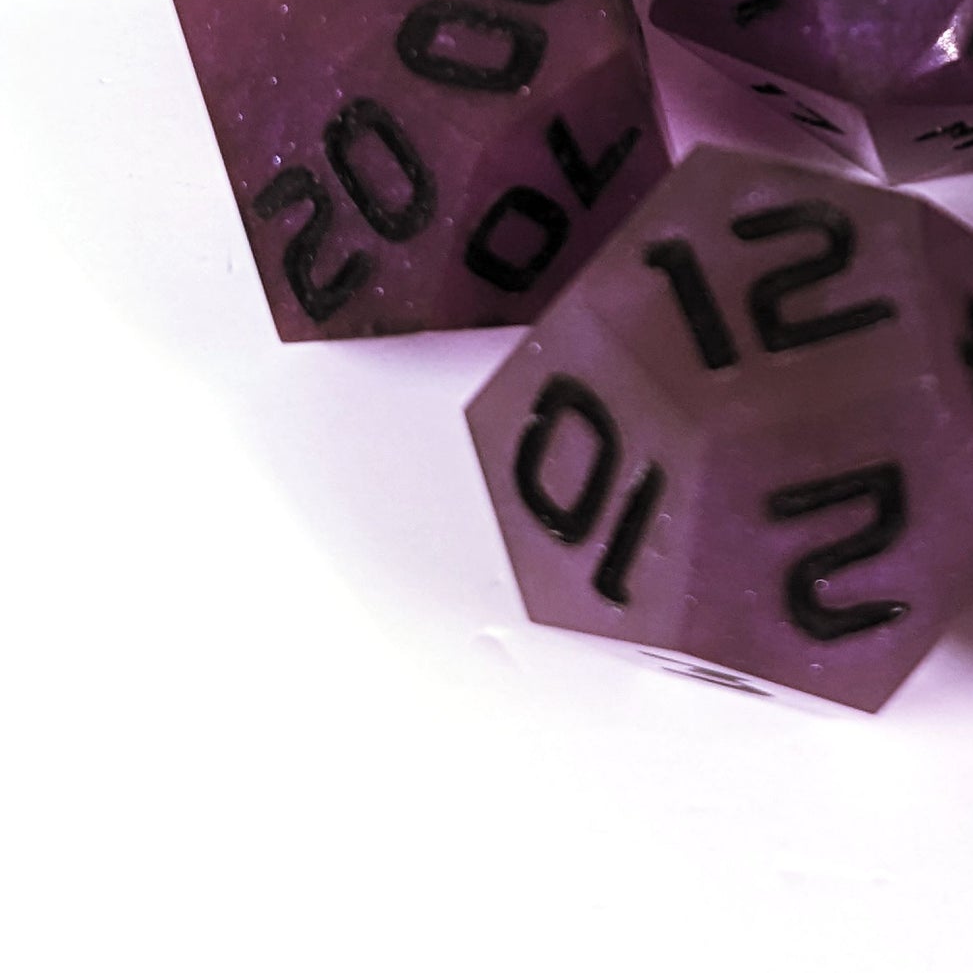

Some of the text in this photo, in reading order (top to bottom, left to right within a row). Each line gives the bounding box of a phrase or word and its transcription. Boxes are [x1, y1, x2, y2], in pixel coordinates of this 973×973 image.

[253, 97, 438, 323] 20
[644, 198, 897, 370] 12
[514, 373, 667, 607] 10
[767, 463, 911, 642] 2
